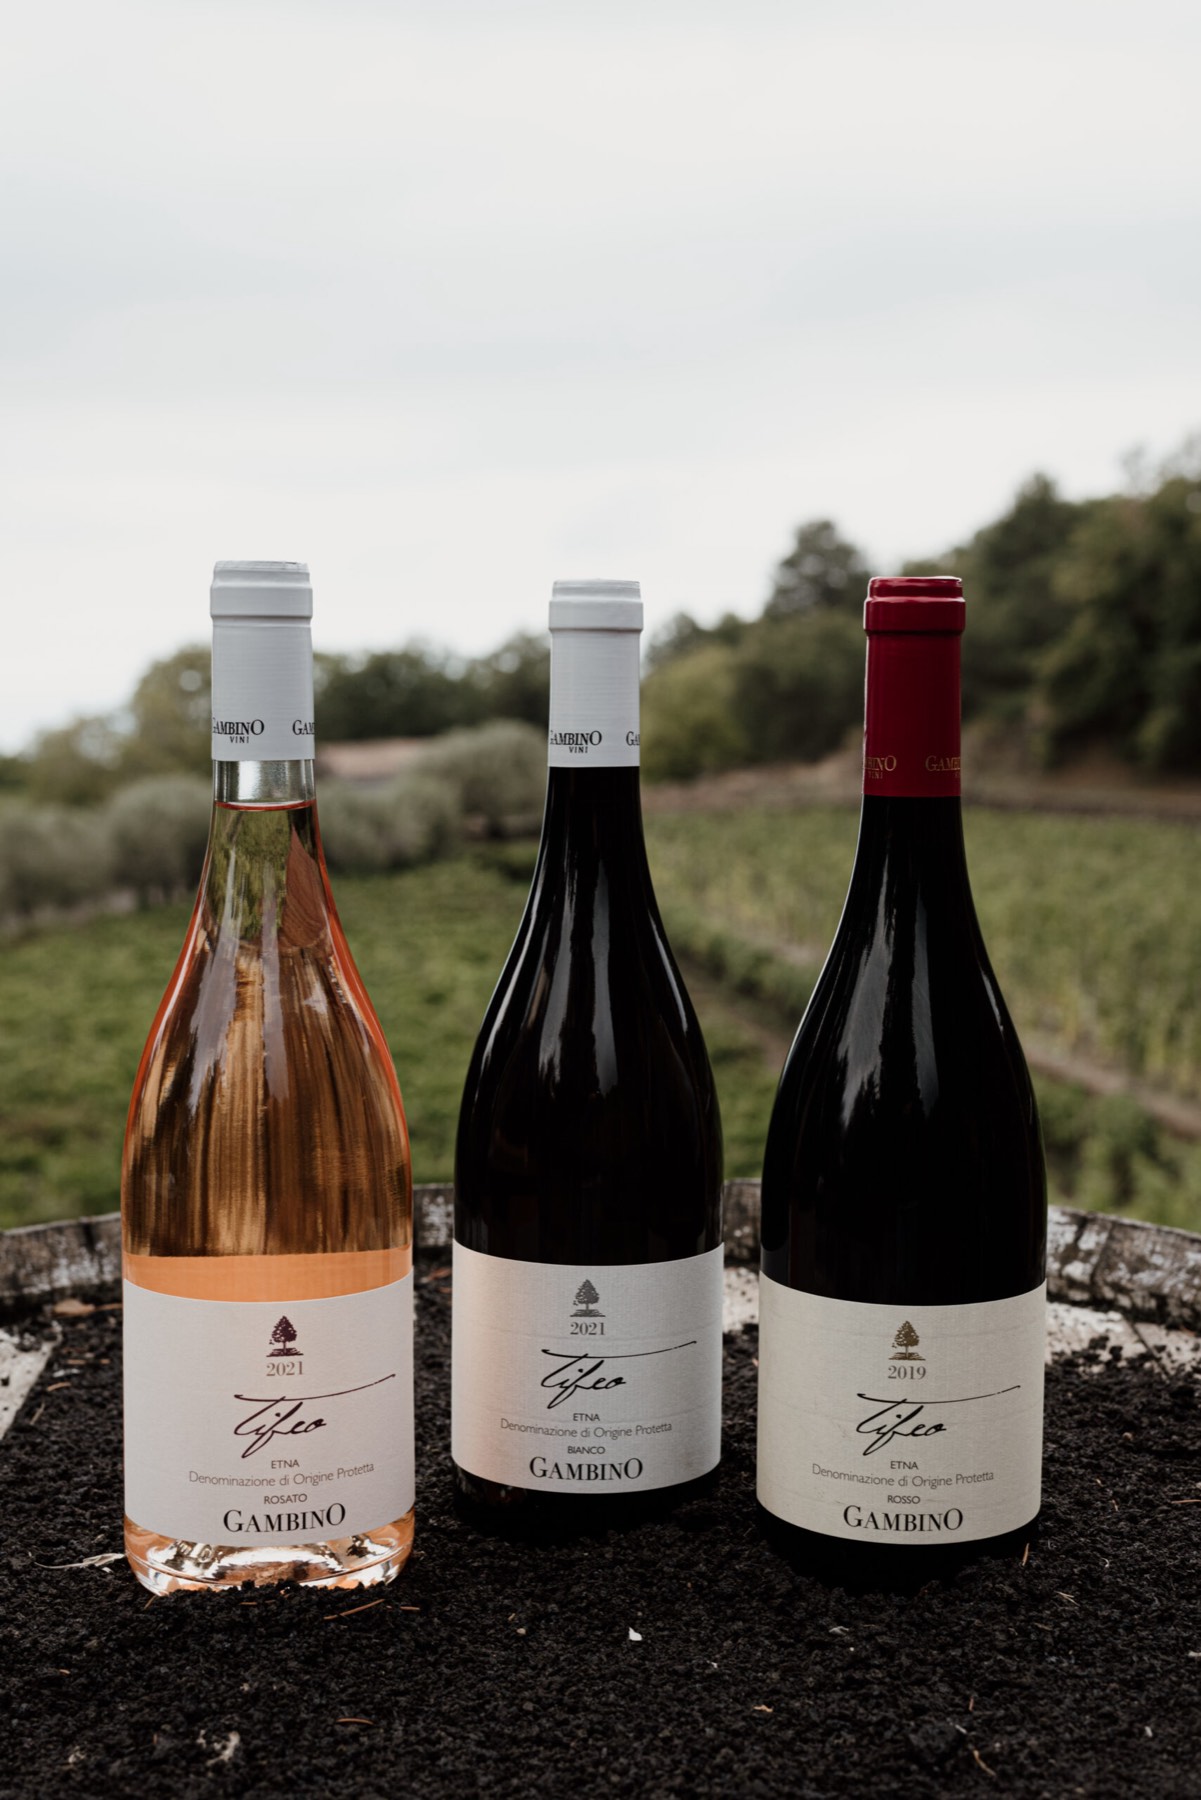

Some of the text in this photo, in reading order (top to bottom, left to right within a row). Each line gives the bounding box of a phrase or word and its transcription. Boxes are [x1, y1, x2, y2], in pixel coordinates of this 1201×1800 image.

[213, 717, 265, 735] AMBINO
[229, 735, 250, 743] VINI
[550, 730, 603, 746] AMBINO
[864, 755, 897, 771] BINO
[570, 1322, 605, 1335] 2021
[266, 1361, 303, 1376] 2021
[888, 1365, 926, 1380] 2019
[573, 1413, 600, 1422] ETNA
[500, 1418, 672, 1440] Denominazione di Origine Protetta
[567, 1445, 606, 1454] BIANCO
[271, 1459, 300, 1469] ETNA
[529, 1456, 643, 1481] GAMBINO
[890, 1461, 919, 1470] ETNA
[188, 1464, 374, 1487] Denominazione di Origine Protetta
[812, 1463, 994, 1490] Denominazione di Origine Protetta
[264, 1493, 307, 1504] ROSATO
[887, 1495, 921, 1504] ROSSO
[223, 1502, 346, 1533] GAMBINO
[843, 1505, 964, 1532] GAMBINO
